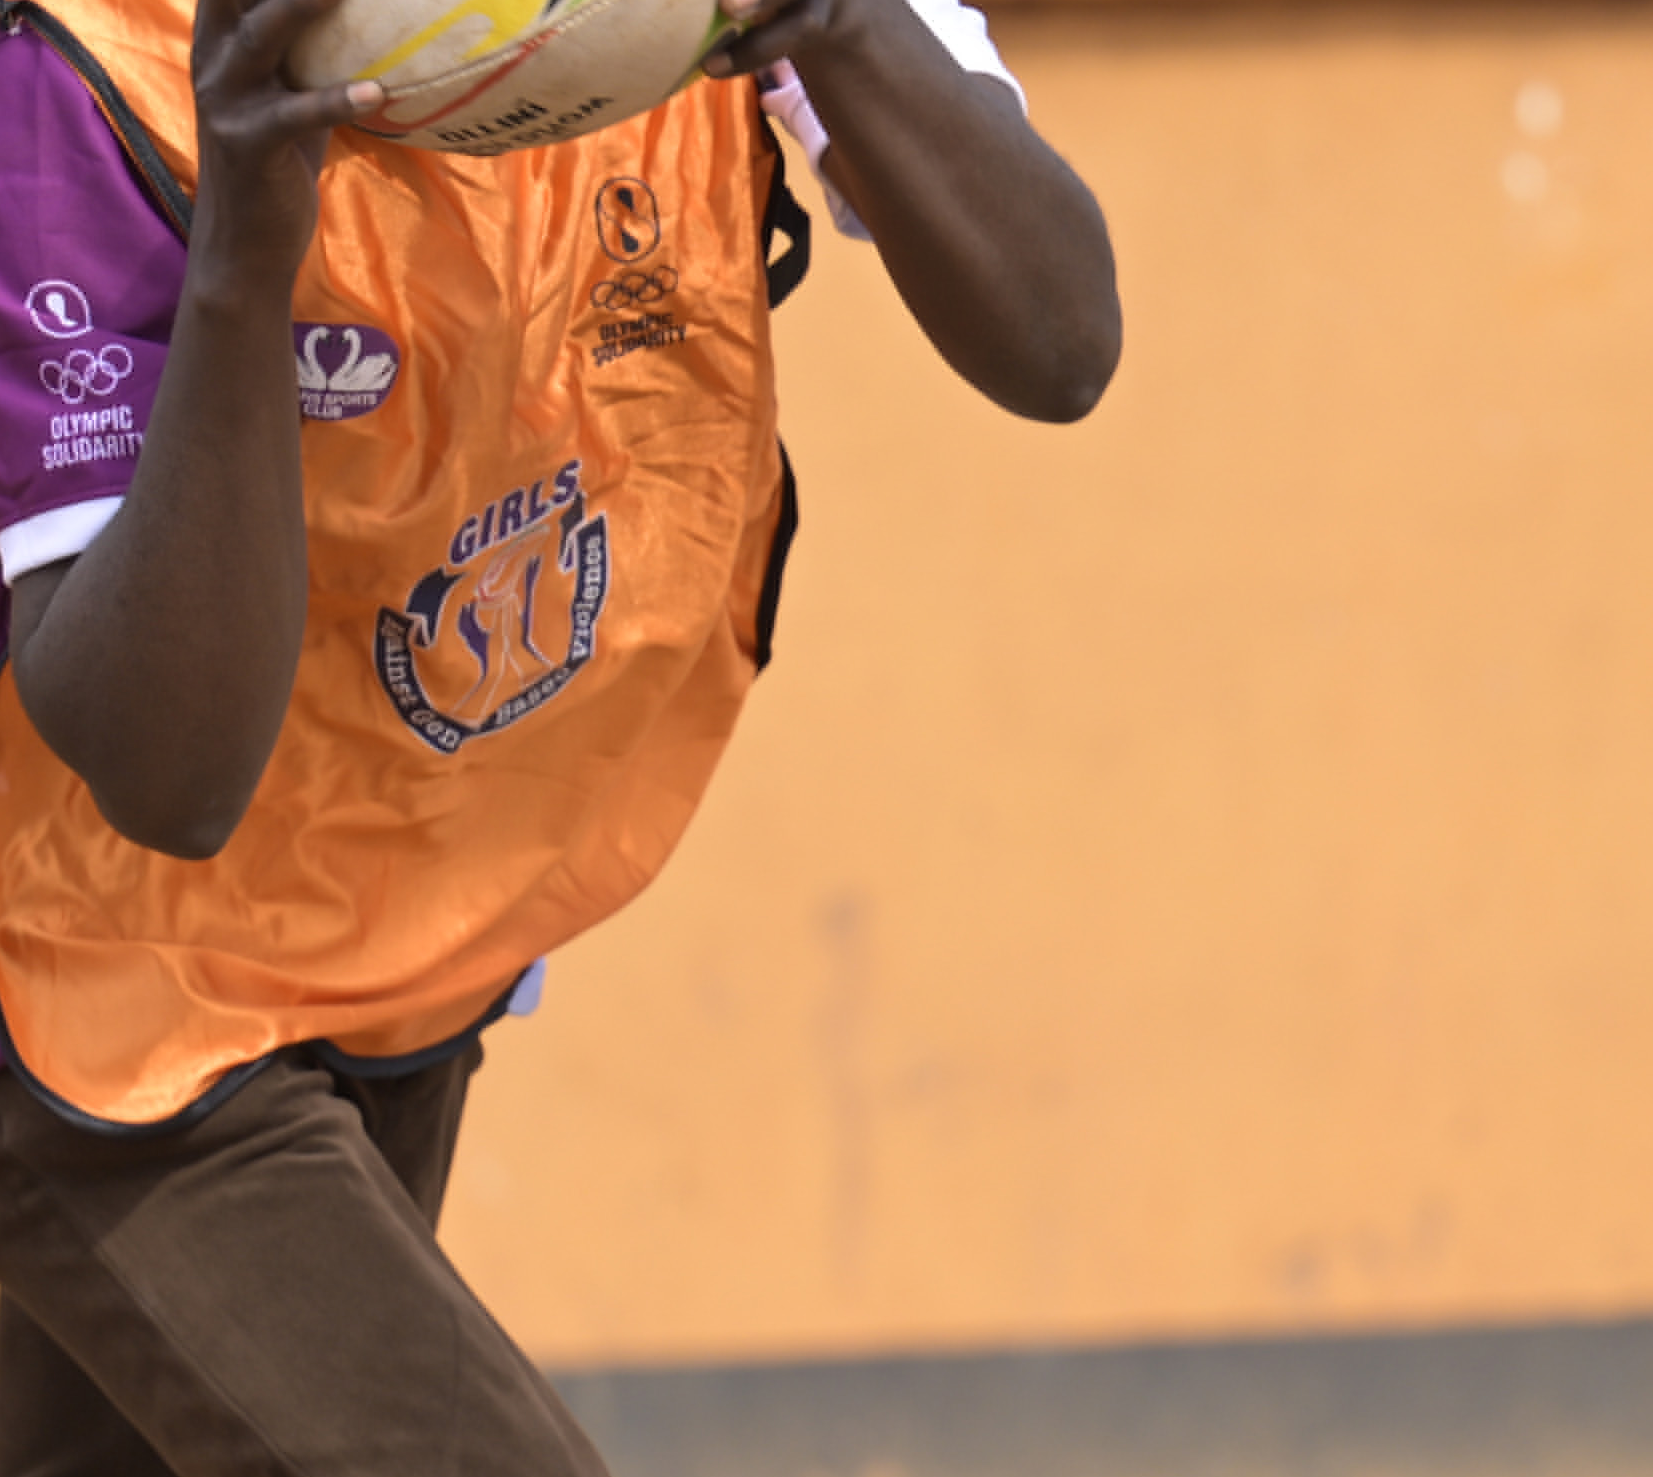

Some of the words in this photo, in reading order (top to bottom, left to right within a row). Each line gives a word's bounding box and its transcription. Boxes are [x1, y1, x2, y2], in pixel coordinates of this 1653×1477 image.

[599, 313, 673, 341] OLYMPIC
[591, 328, 686, 368] SOLIDARITY
[301, 402, 343, 418] CLUB
[324, 393, 378, 408] SPORTS
[49, 404, 134, 440] OLYMPIC
[448, 458, 582, 565] GIRLS
[571, 533, 604, 661] Violence
